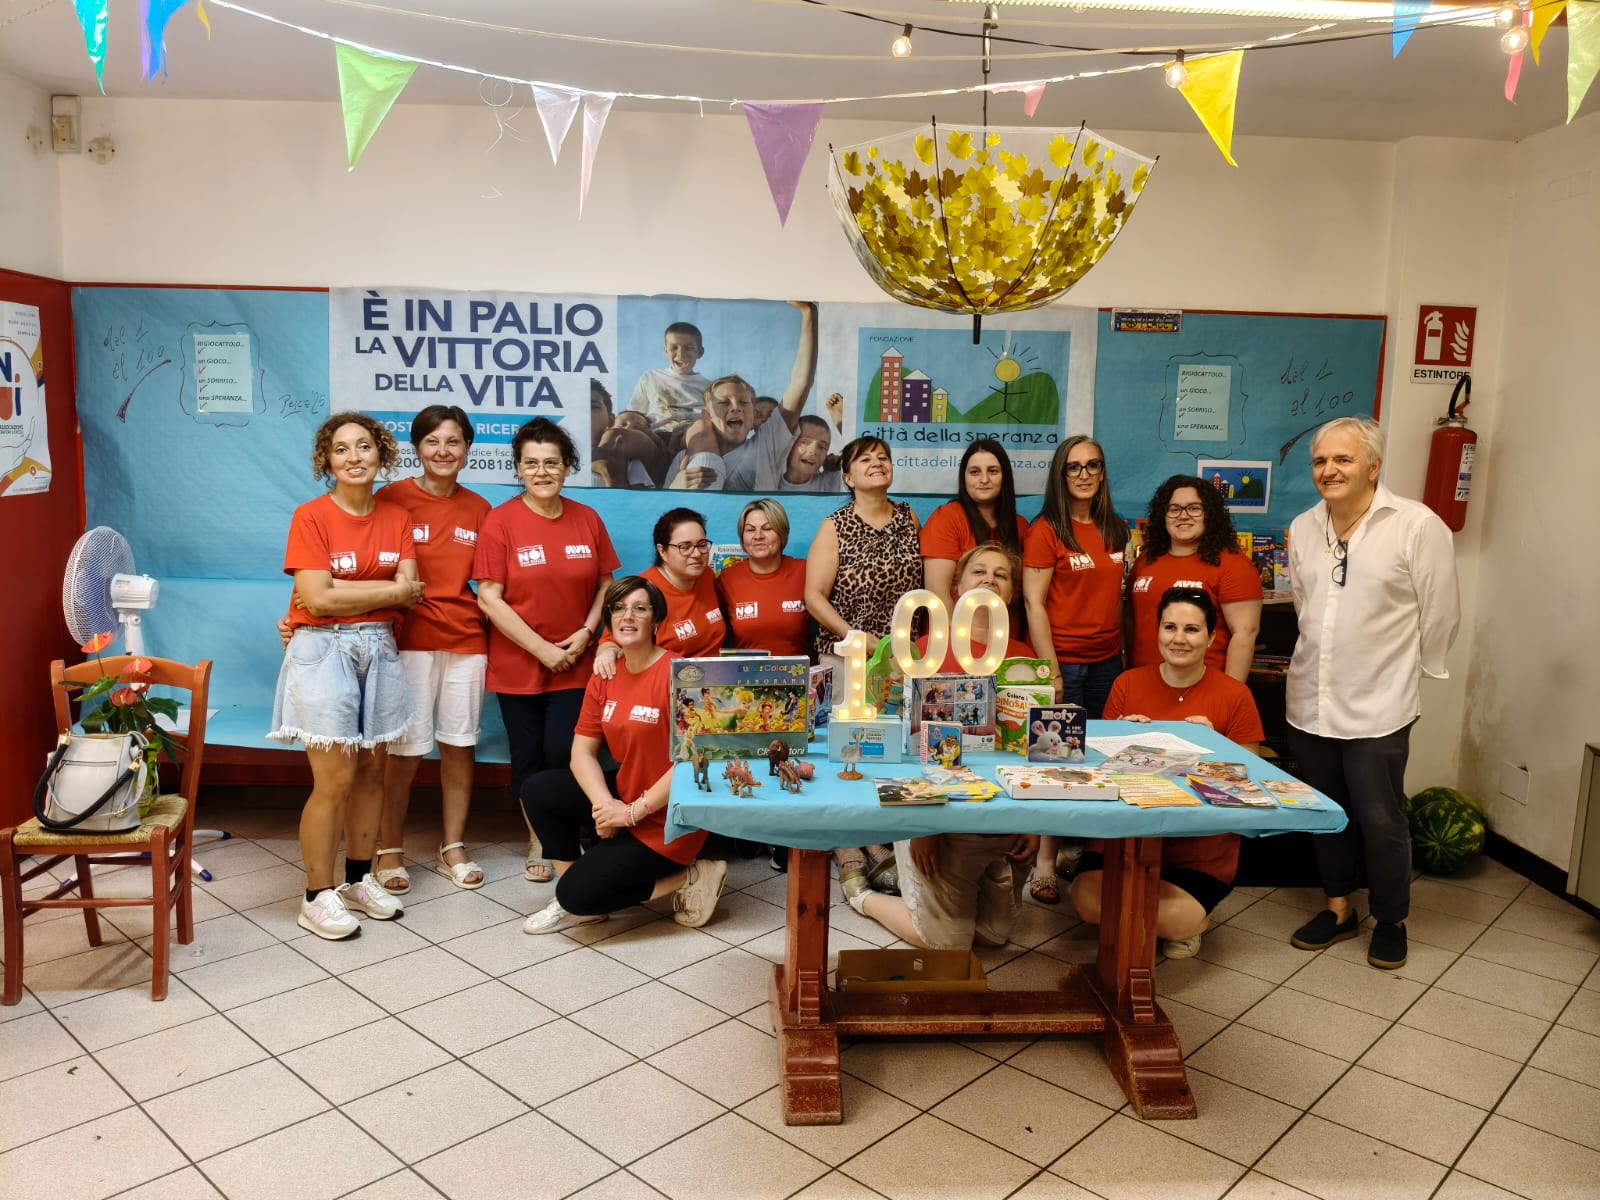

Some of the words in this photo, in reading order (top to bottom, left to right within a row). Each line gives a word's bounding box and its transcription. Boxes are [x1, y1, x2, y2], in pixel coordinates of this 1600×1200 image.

[363, 290, 389, 331] È
[405, 299, 452, 332] IN
[470, 301, 603, 336] PALIO
[355, 336, 387, 354] LA
[392, 336, 609, 374] VITTORIA
[869, 336, 915, 344] FONDAZIONE
[375, 373, 455, 393] DELLA
[460, 374, 564, 409] VITA
[862, 427, 909, 442] città
[914, 427, 961, 443] della
[964, 431, 1058, 444] speranza
